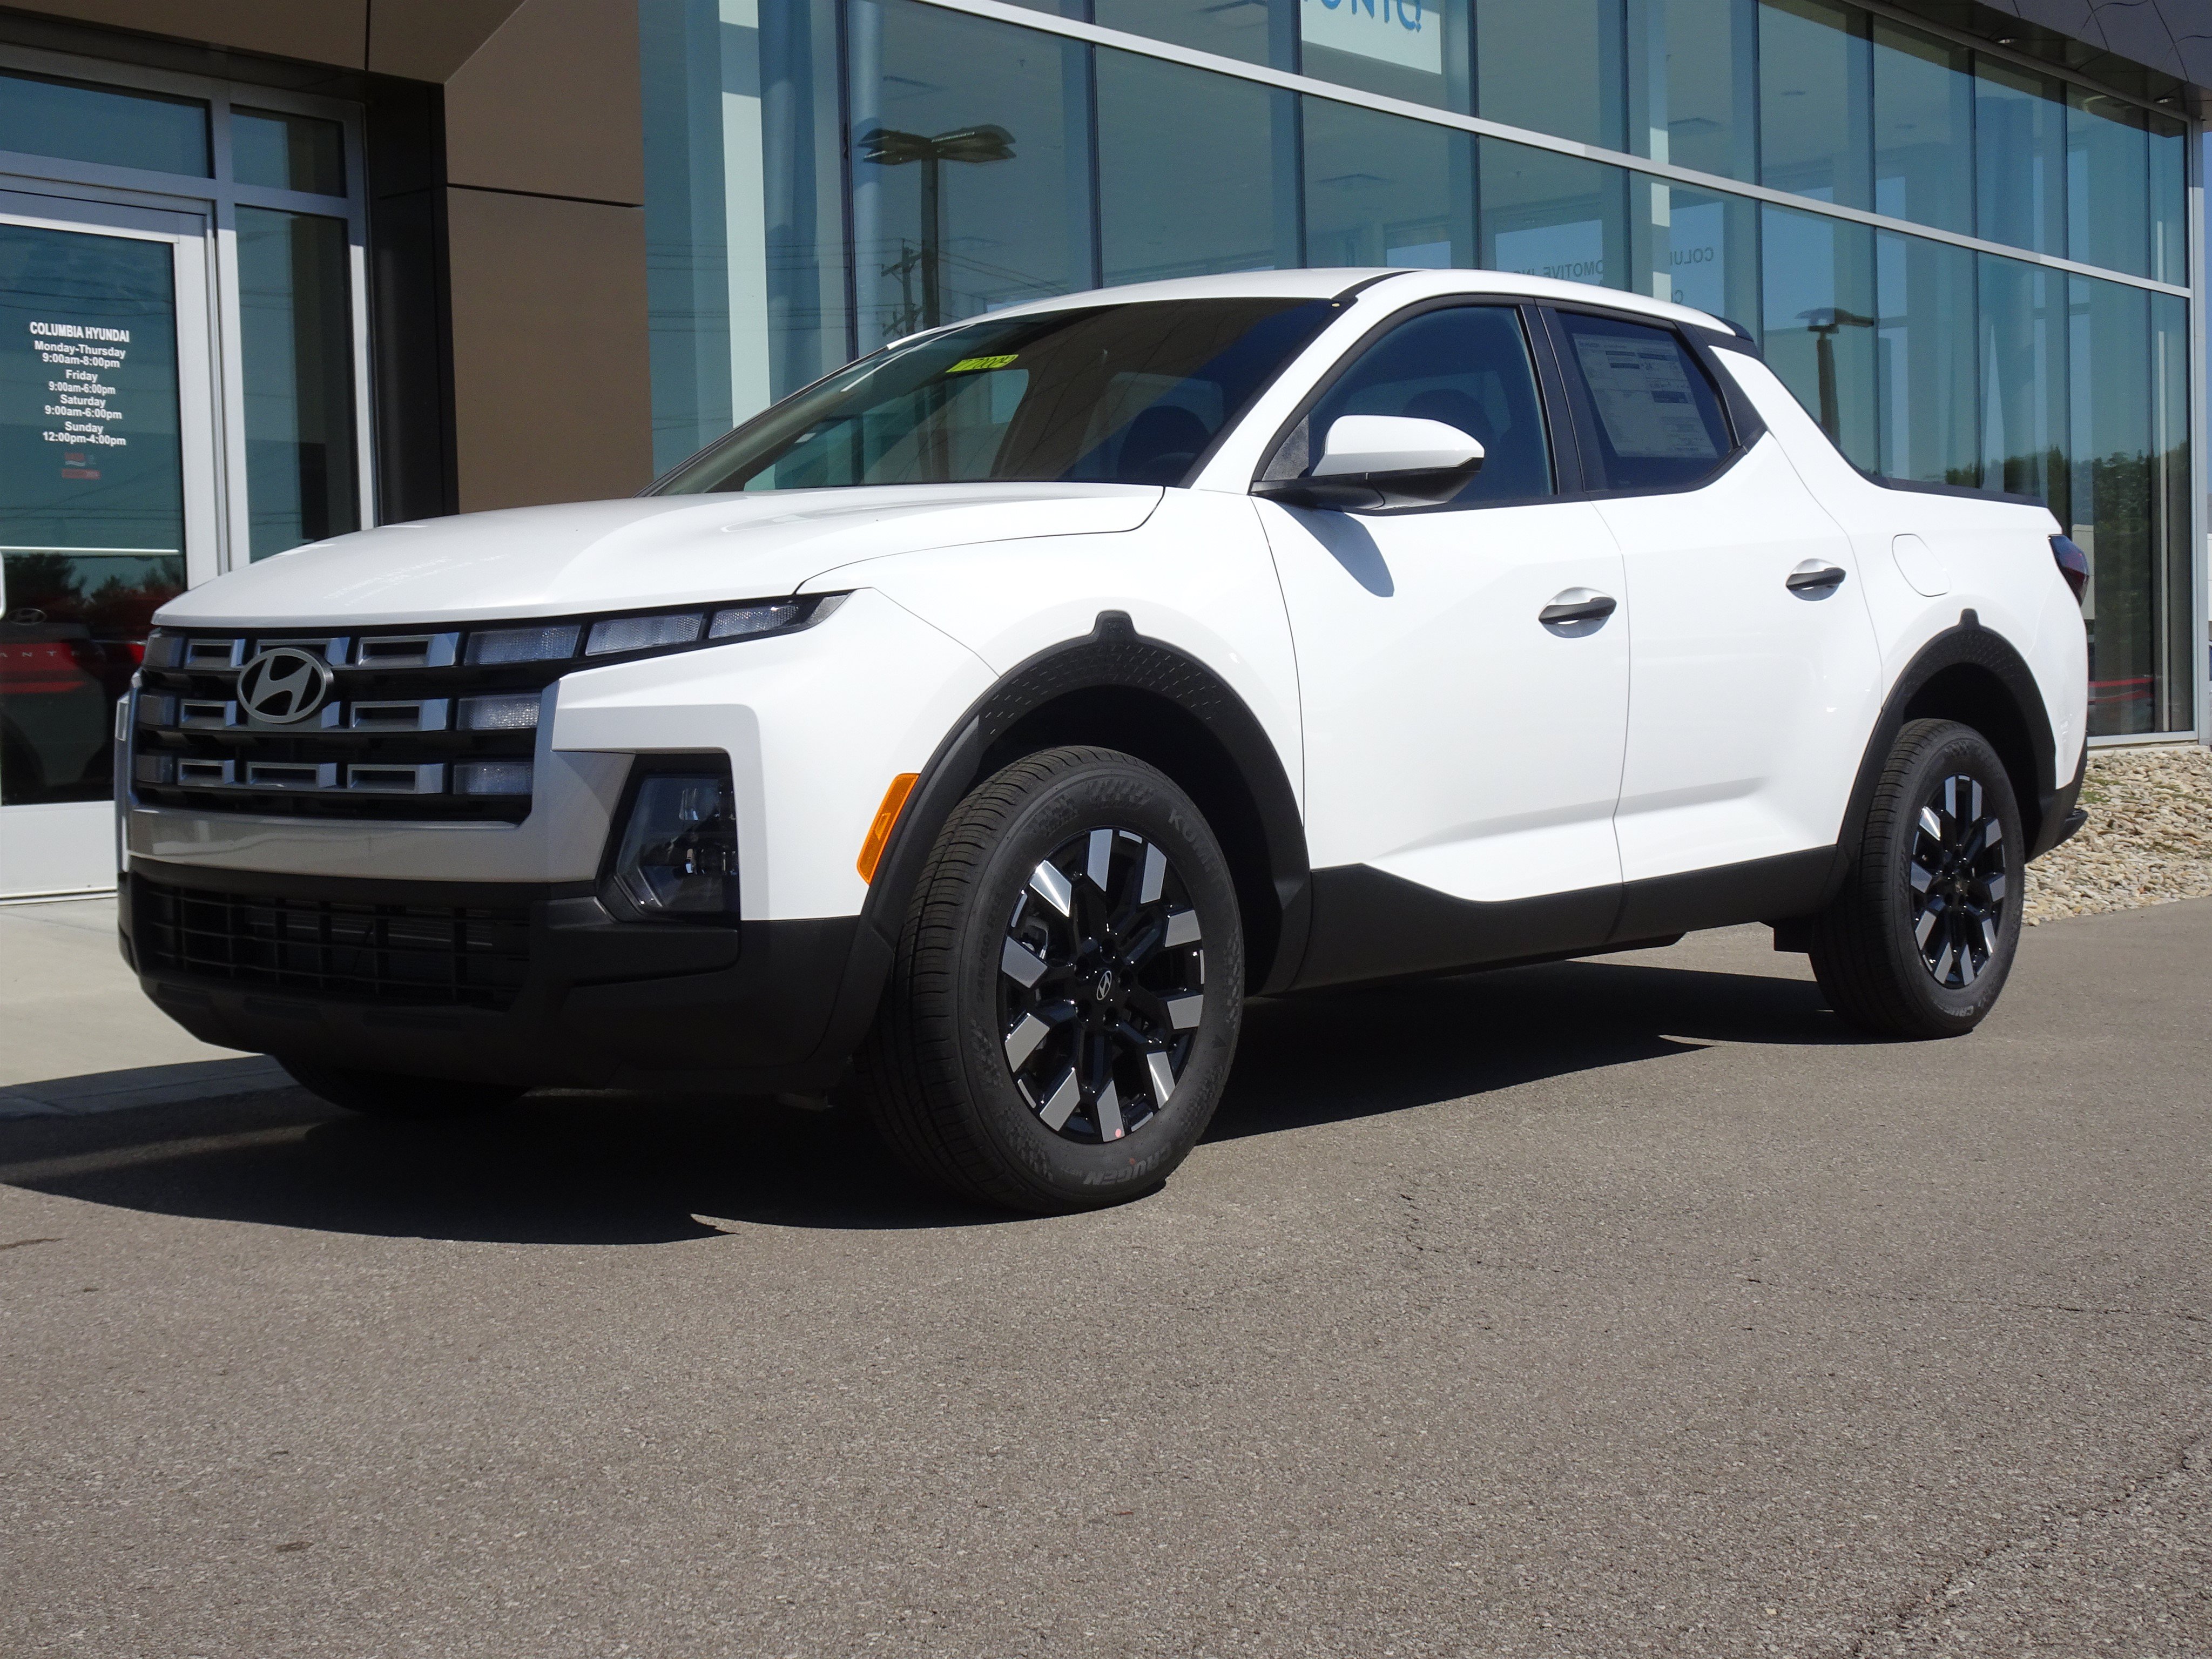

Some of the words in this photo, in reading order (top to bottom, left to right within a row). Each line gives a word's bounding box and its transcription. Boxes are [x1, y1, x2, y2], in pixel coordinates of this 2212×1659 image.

[30, 321, 84, 339] COLUMBIA
[85, 326, 130, 342] HYUNDAI
[34, 340, 126, 359] Monday-Thursday
[42, 353, 120, 368] 9:00am-8:00pm
[65, 369, 98, 383] Friday
[49, 381, 116, 395] 9:00am-6:00pm
[60, 394, 106, 408] Saturday
[45, 405, 123, 420] 9:00am-6:00pm
[65, 421, 103, 434] Sunday
[43, 431, 126, 447] 12:00pm-4:00pm
